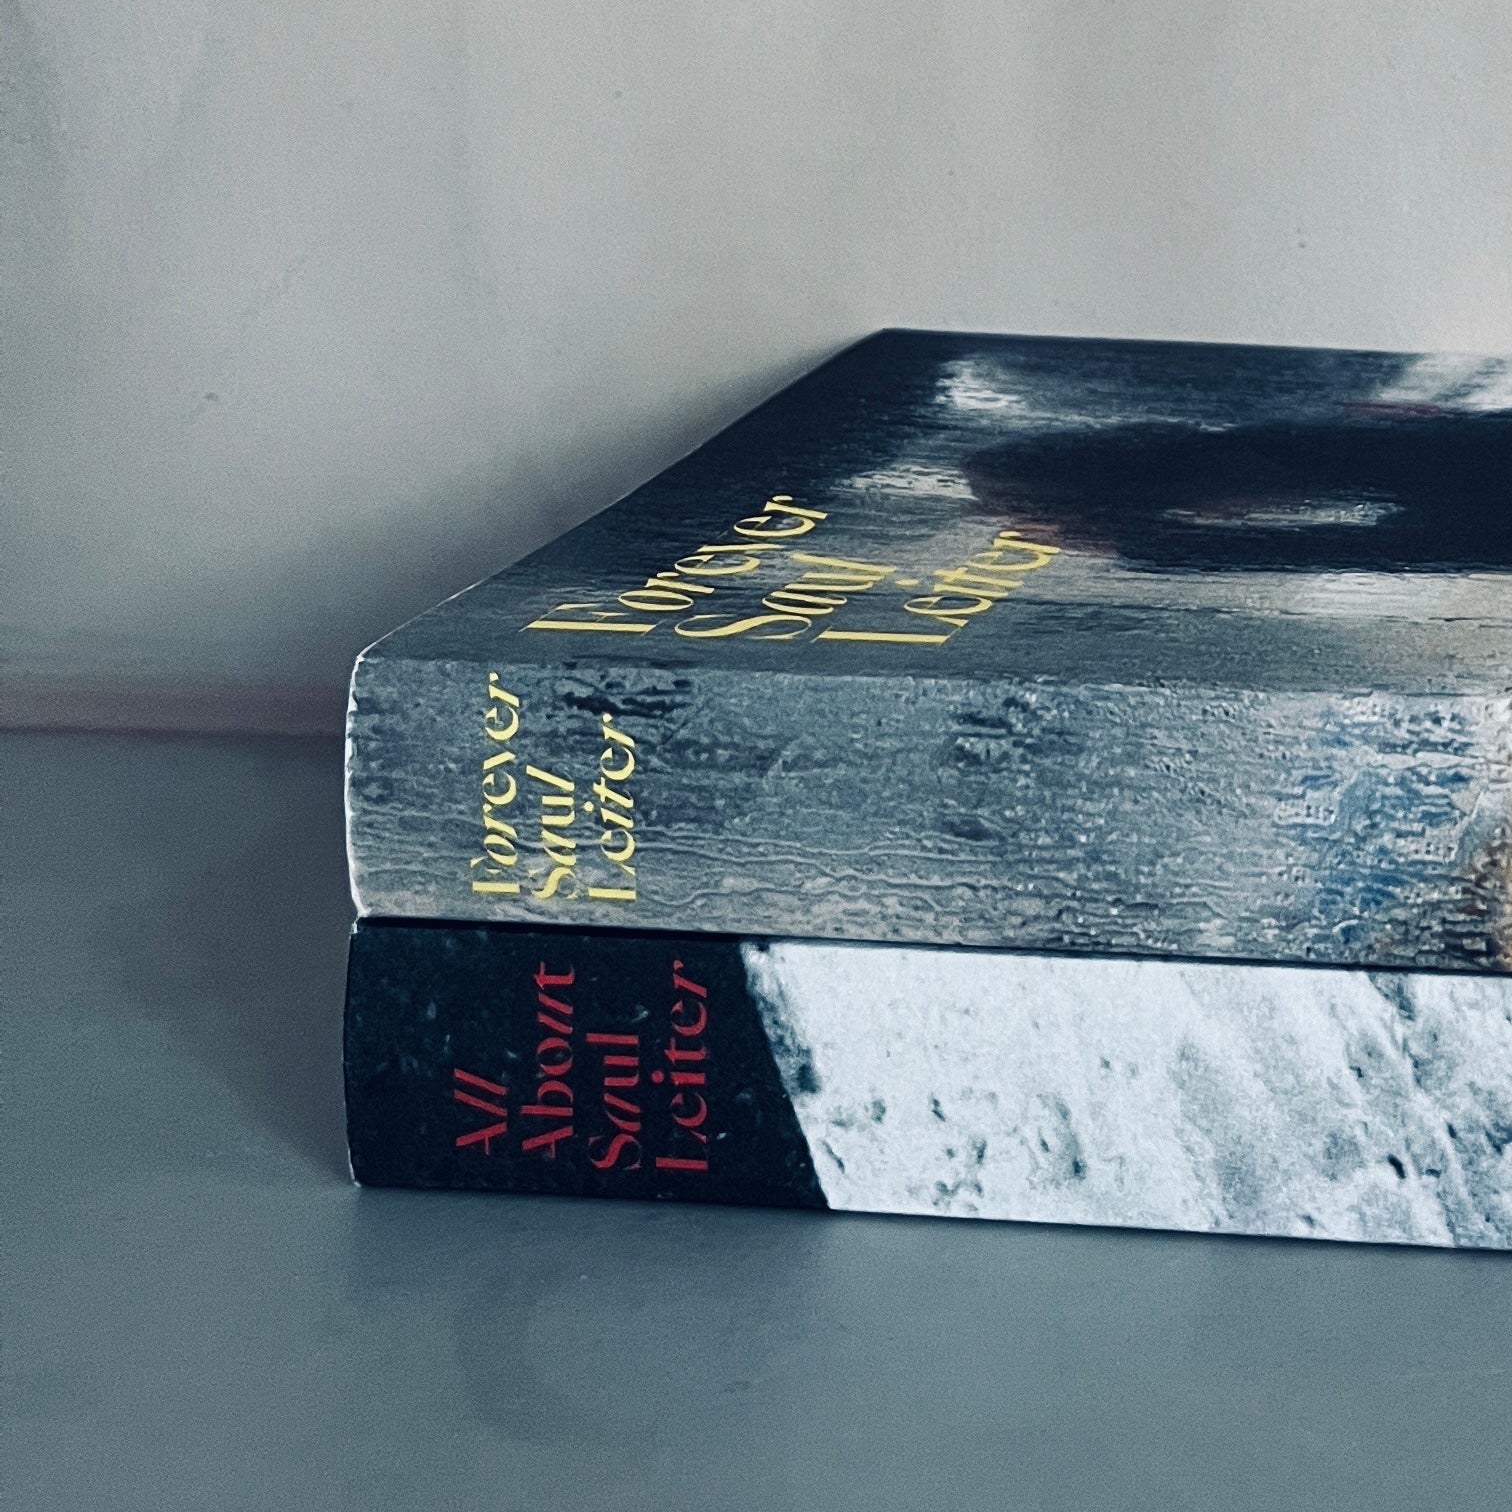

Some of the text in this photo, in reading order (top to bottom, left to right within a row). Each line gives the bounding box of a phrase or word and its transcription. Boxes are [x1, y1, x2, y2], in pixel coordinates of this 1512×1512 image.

[519, 494, 829, 636] Forever
[675, 552, 899, 641] Saul
[813, 529, 1061, 646] Leiter
[470, 671, 520, 895] Forever
[526, 763, 577, 902] Saul
[583, 712, 638, 902] Leiter
[454, 1068, 508, 1157] All
[521, 960, 576, 1160] About
[588, 1032, 642, 1172] Saul
[652, 958, 709, 1171] Leiter
